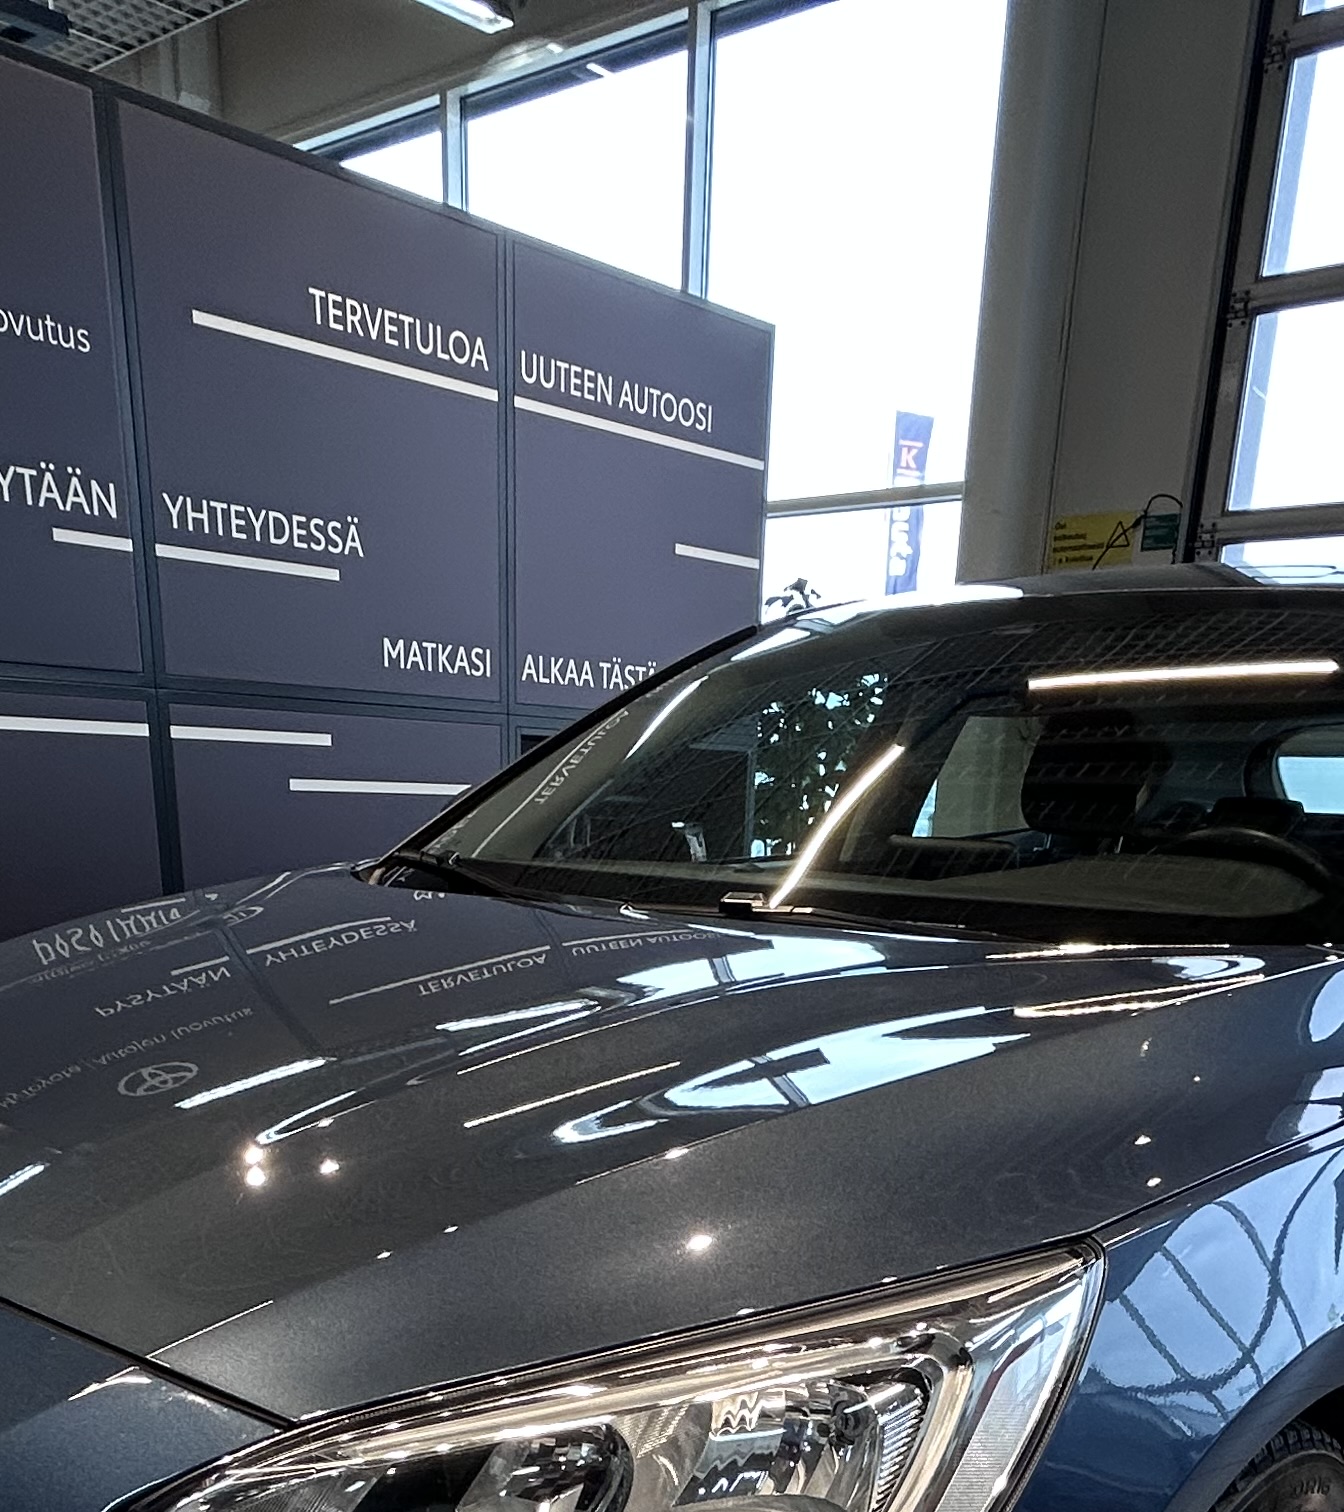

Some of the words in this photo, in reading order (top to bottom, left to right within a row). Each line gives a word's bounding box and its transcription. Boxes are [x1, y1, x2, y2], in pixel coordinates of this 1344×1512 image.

[308, 286, 489, 371] TERVETULOA
[521, 349, 612, 406] UUTEEN
[618, 380, 713, 433] AUTOOSI
[162, 492, 364, 558] YHTEYDESSÄ
[383, 637, 491, 677] MATKASI
[521, 654, 594, 688] ALKAA
